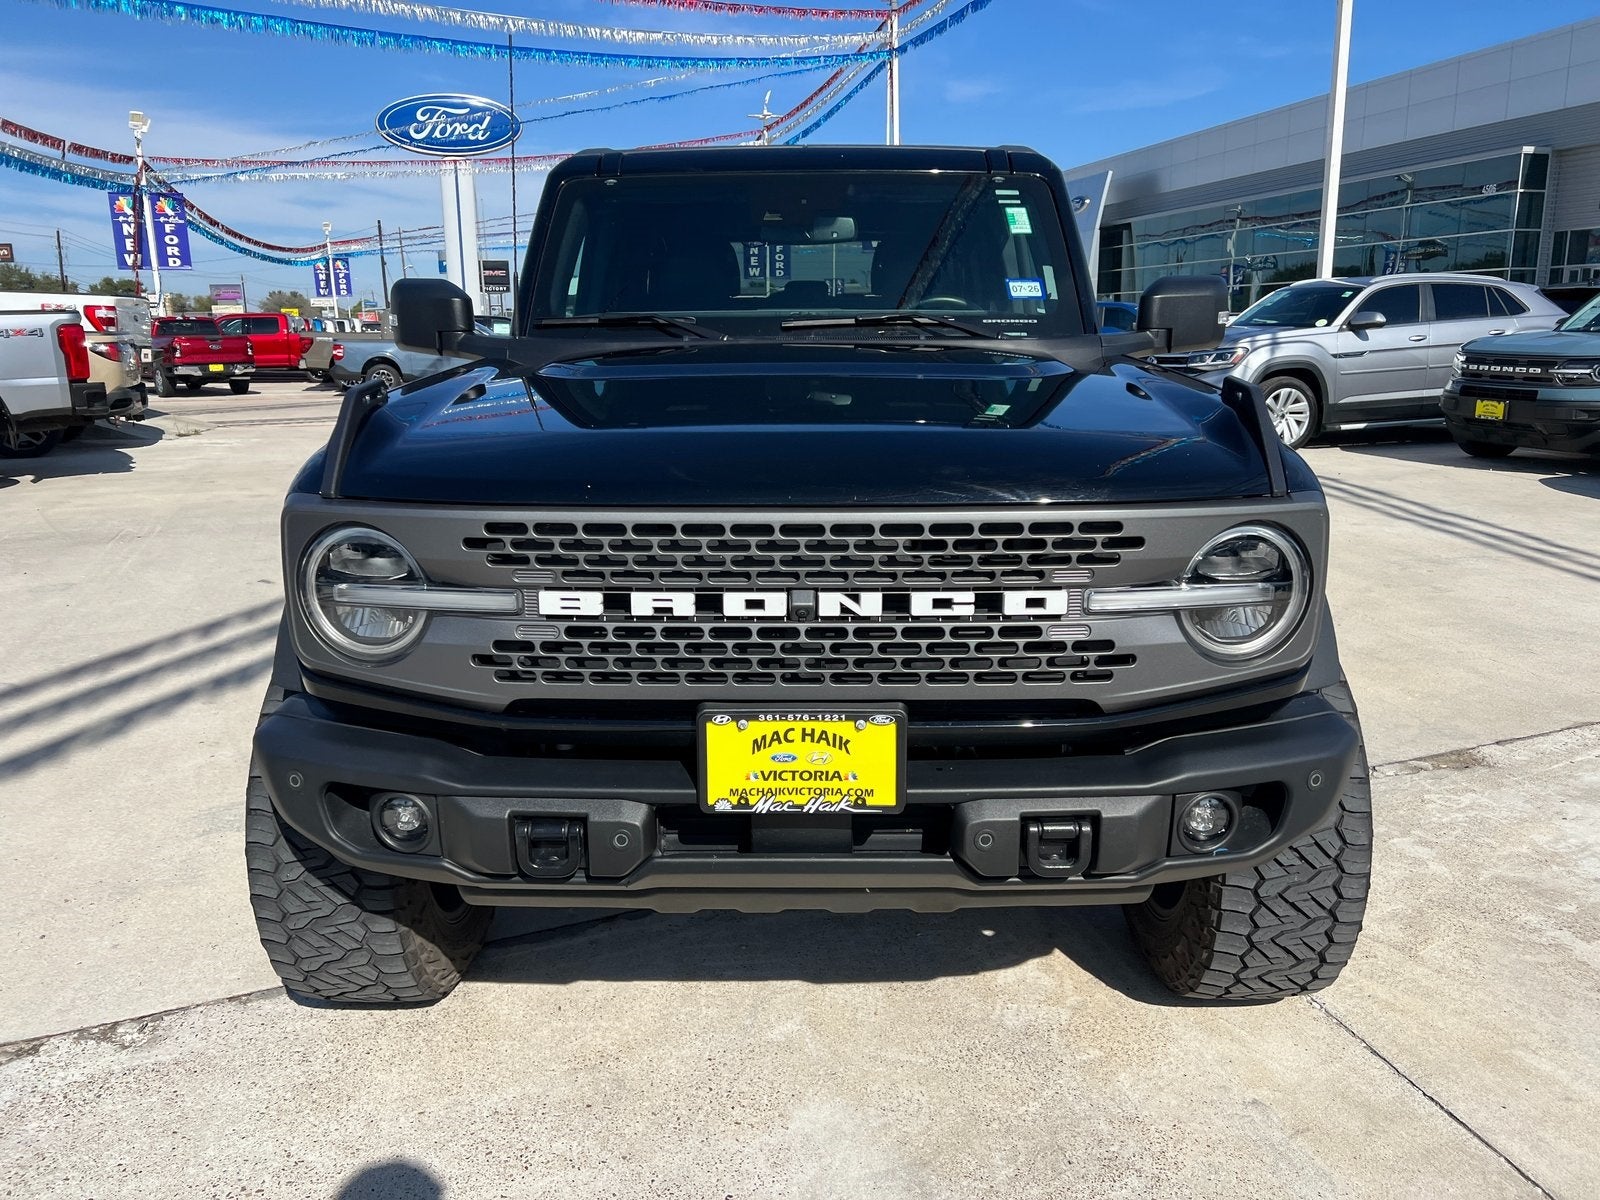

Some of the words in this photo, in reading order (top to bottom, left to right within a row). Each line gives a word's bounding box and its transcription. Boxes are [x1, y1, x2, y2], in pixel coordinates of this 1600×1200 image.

[409, 105, 491, 141] Ford
[122, 223, 142, 266] NEW
[164, 223, 182, 267] FORD
[748, 247, 760, 277] NEW
[775, 245, 785, 277] FORD
[318, 273, 329, 296] NEW
[338, 272, 348, 296] FORD
[1468, 364, 1542, 374] BRONCO
[538, 590, 1068, 617] BRONCO
[758, 714, 847, 722] 361-576-1221
[751, 727, 796, 756] MAC
[800, 727, 852, 756] HAIK
[760, 770, 844, 782] VICTORIA
[752, 794, 801, 814] Mac
[802, 794, 855, 814] Haik
